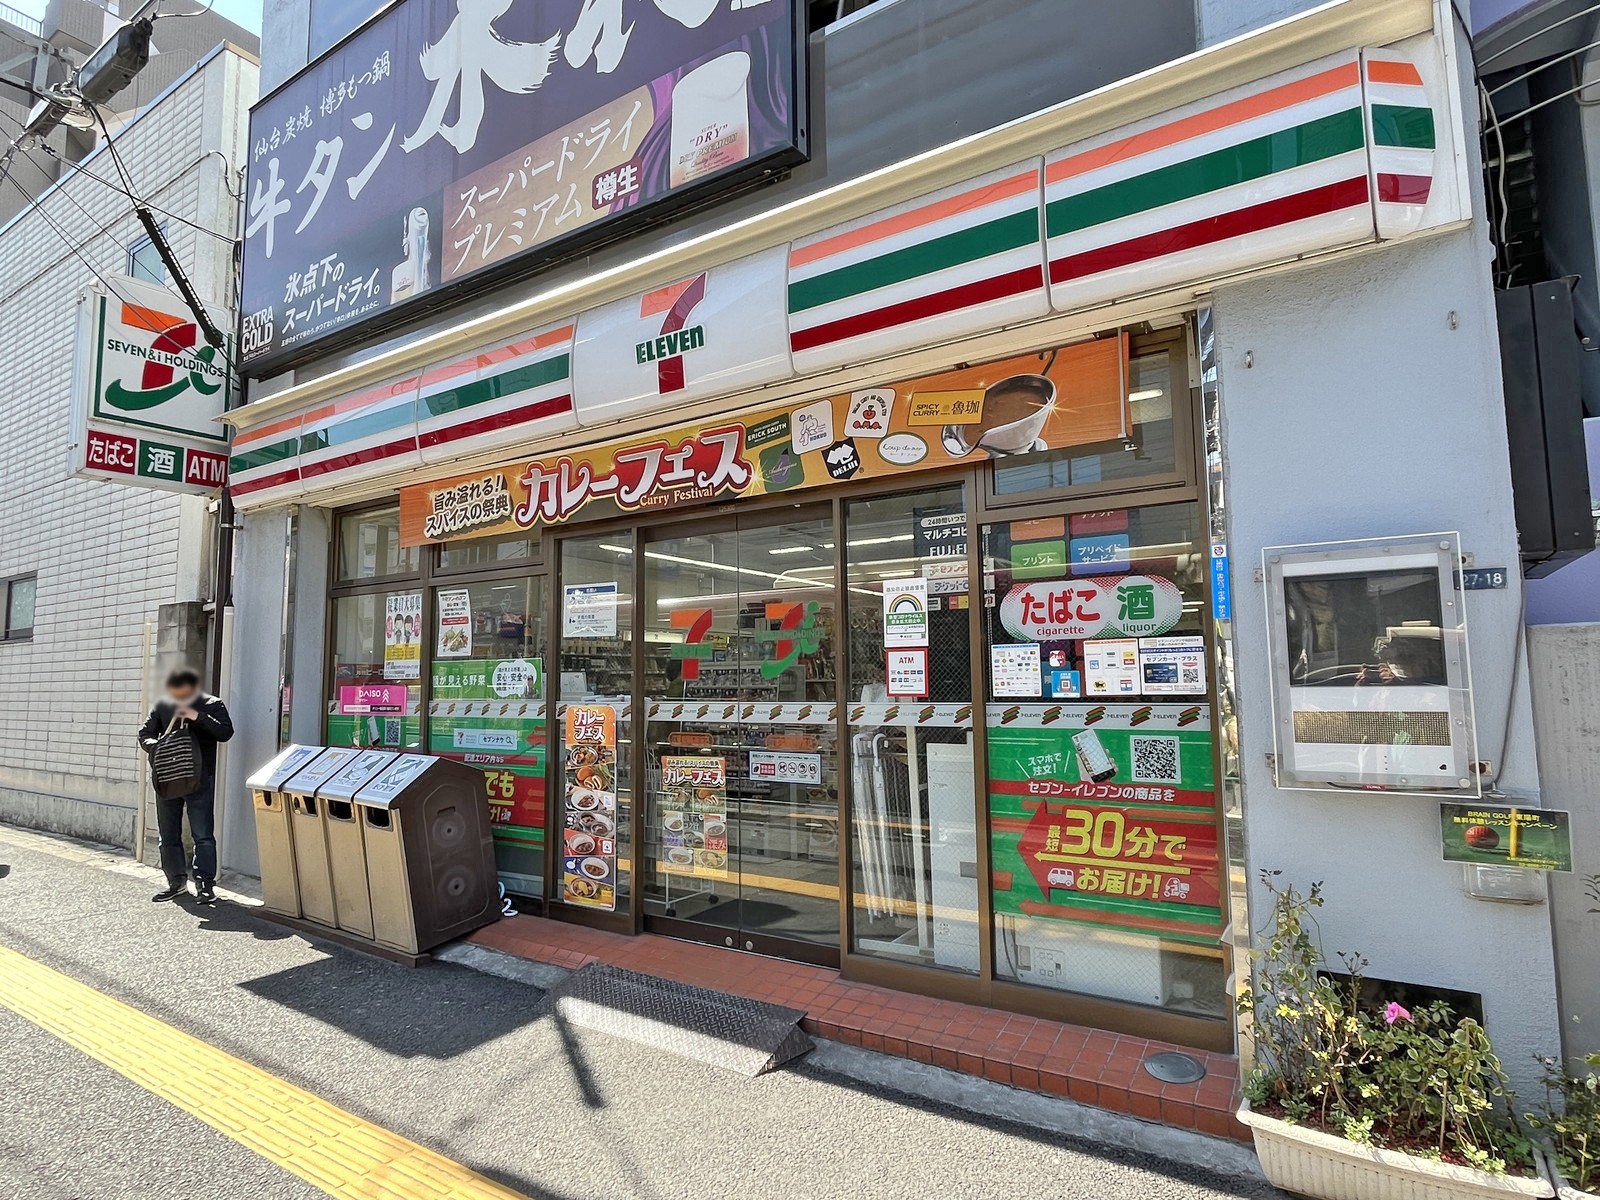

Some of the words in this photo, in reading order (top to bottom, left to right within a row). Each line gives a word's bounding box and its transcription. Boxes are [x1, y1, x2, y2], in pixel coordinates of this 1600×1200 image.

[319, 49, 392, 118] 博多もつ鍋
[696, 132, 738, 158] PREMIUM
[450, 100, 643, 230] スーパードライ
[245, 111, 397, 260] 牛タン
[595, 165, 639, 205] 樽生
[451, 183, 582, 276] プレミアム
[283, 252, 345, 303] 氷点下の
[242, 305, 274, 335] EXTRA
[241, 322, 274, 354] COLD
[164, 353, 224, 378] HOLDINGS
[950, 399, 981, 415] 魯珈
[766, 422, 788, 434] SOUTH
[88, 436, 134, 468] たばこ
[146, 446, 176, 475] 酒
[188, 454, 226, 484] ATM
[515, 430, 749, 525] カレーフェス
[639, 490, 671, 508] Curry
[673, 485, 713, 503] Festival
[424, 493, 510, 532] スパイスの祭典
[1022, 554, 1055, 567] プリント
[1020, 589, 1101, 625] たばこ
[1116, 584, 1155, 621] 酒
[1036, 625, 1085, 637] cigarette
[1122, 622, 1157, 633] liquor
[898, 656, 915, 664] ATM
[359, 690, 381, 698] DAISO
[574, 708, 605, 726] カレー
[483, 736, 505, 744] セブンナウ
[574, 725, 605, 742] フェス
[1027, 752, 1062, 767] スマホで
[1032, 763, 1057, 776] 注文!
[484, 771, 516, 798] でも
[663, 769, 725, 786] カレーフェス
[1028, 781, 1176, 802] セブン-イレブンの商品を
[1467, 810, 1491, 818] BRAIN
[1492, 812, 1513, 820] GOLF
[1045, 825, 1061, 852] 最短
[1061, 808, 1187, 861] 30分で
[1076, 867, 1162, 899] お届け!
